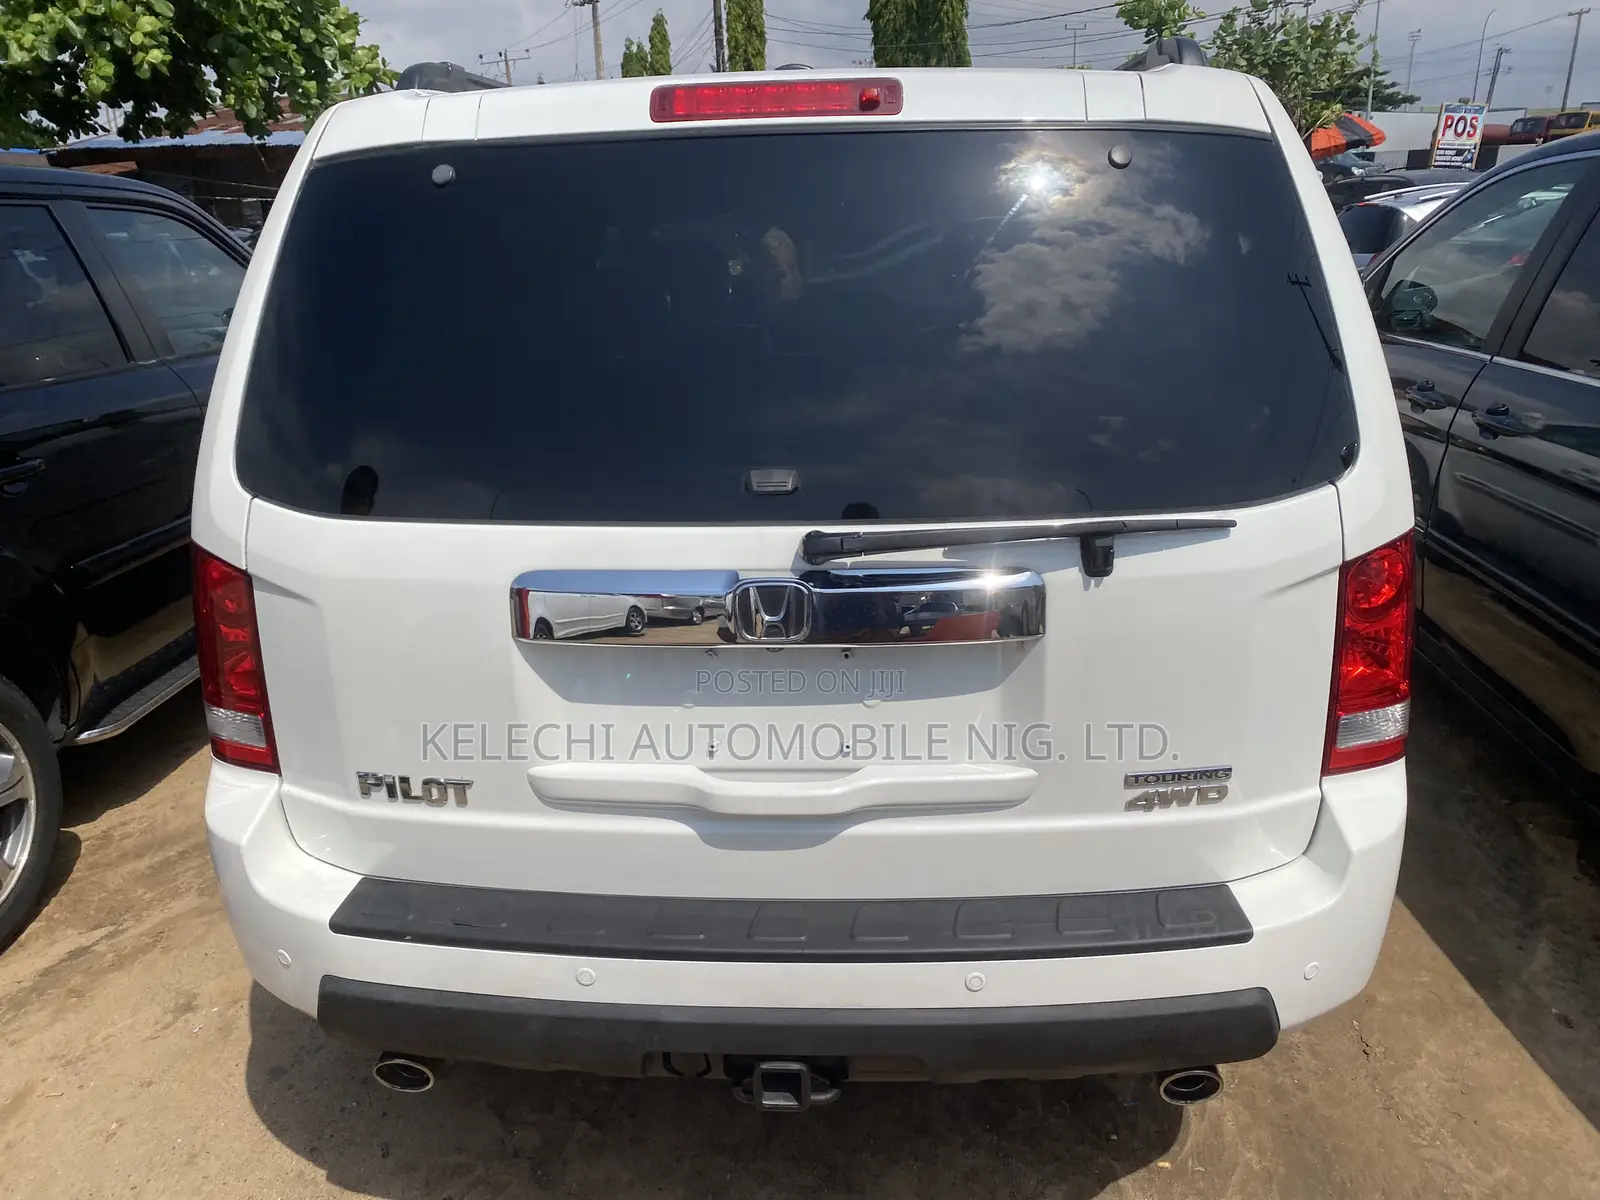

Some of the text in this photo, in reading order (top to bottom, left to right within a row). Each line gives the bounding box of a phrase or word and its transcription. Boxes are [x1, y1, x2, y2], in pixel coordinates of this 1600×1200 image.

[1441, 114, 1479, 138] POS
[356, 771, 475, 808] PILOT
[1129, 767, 1231, 786] TOURING
[1124, 784, 1229, 812] 4WD
